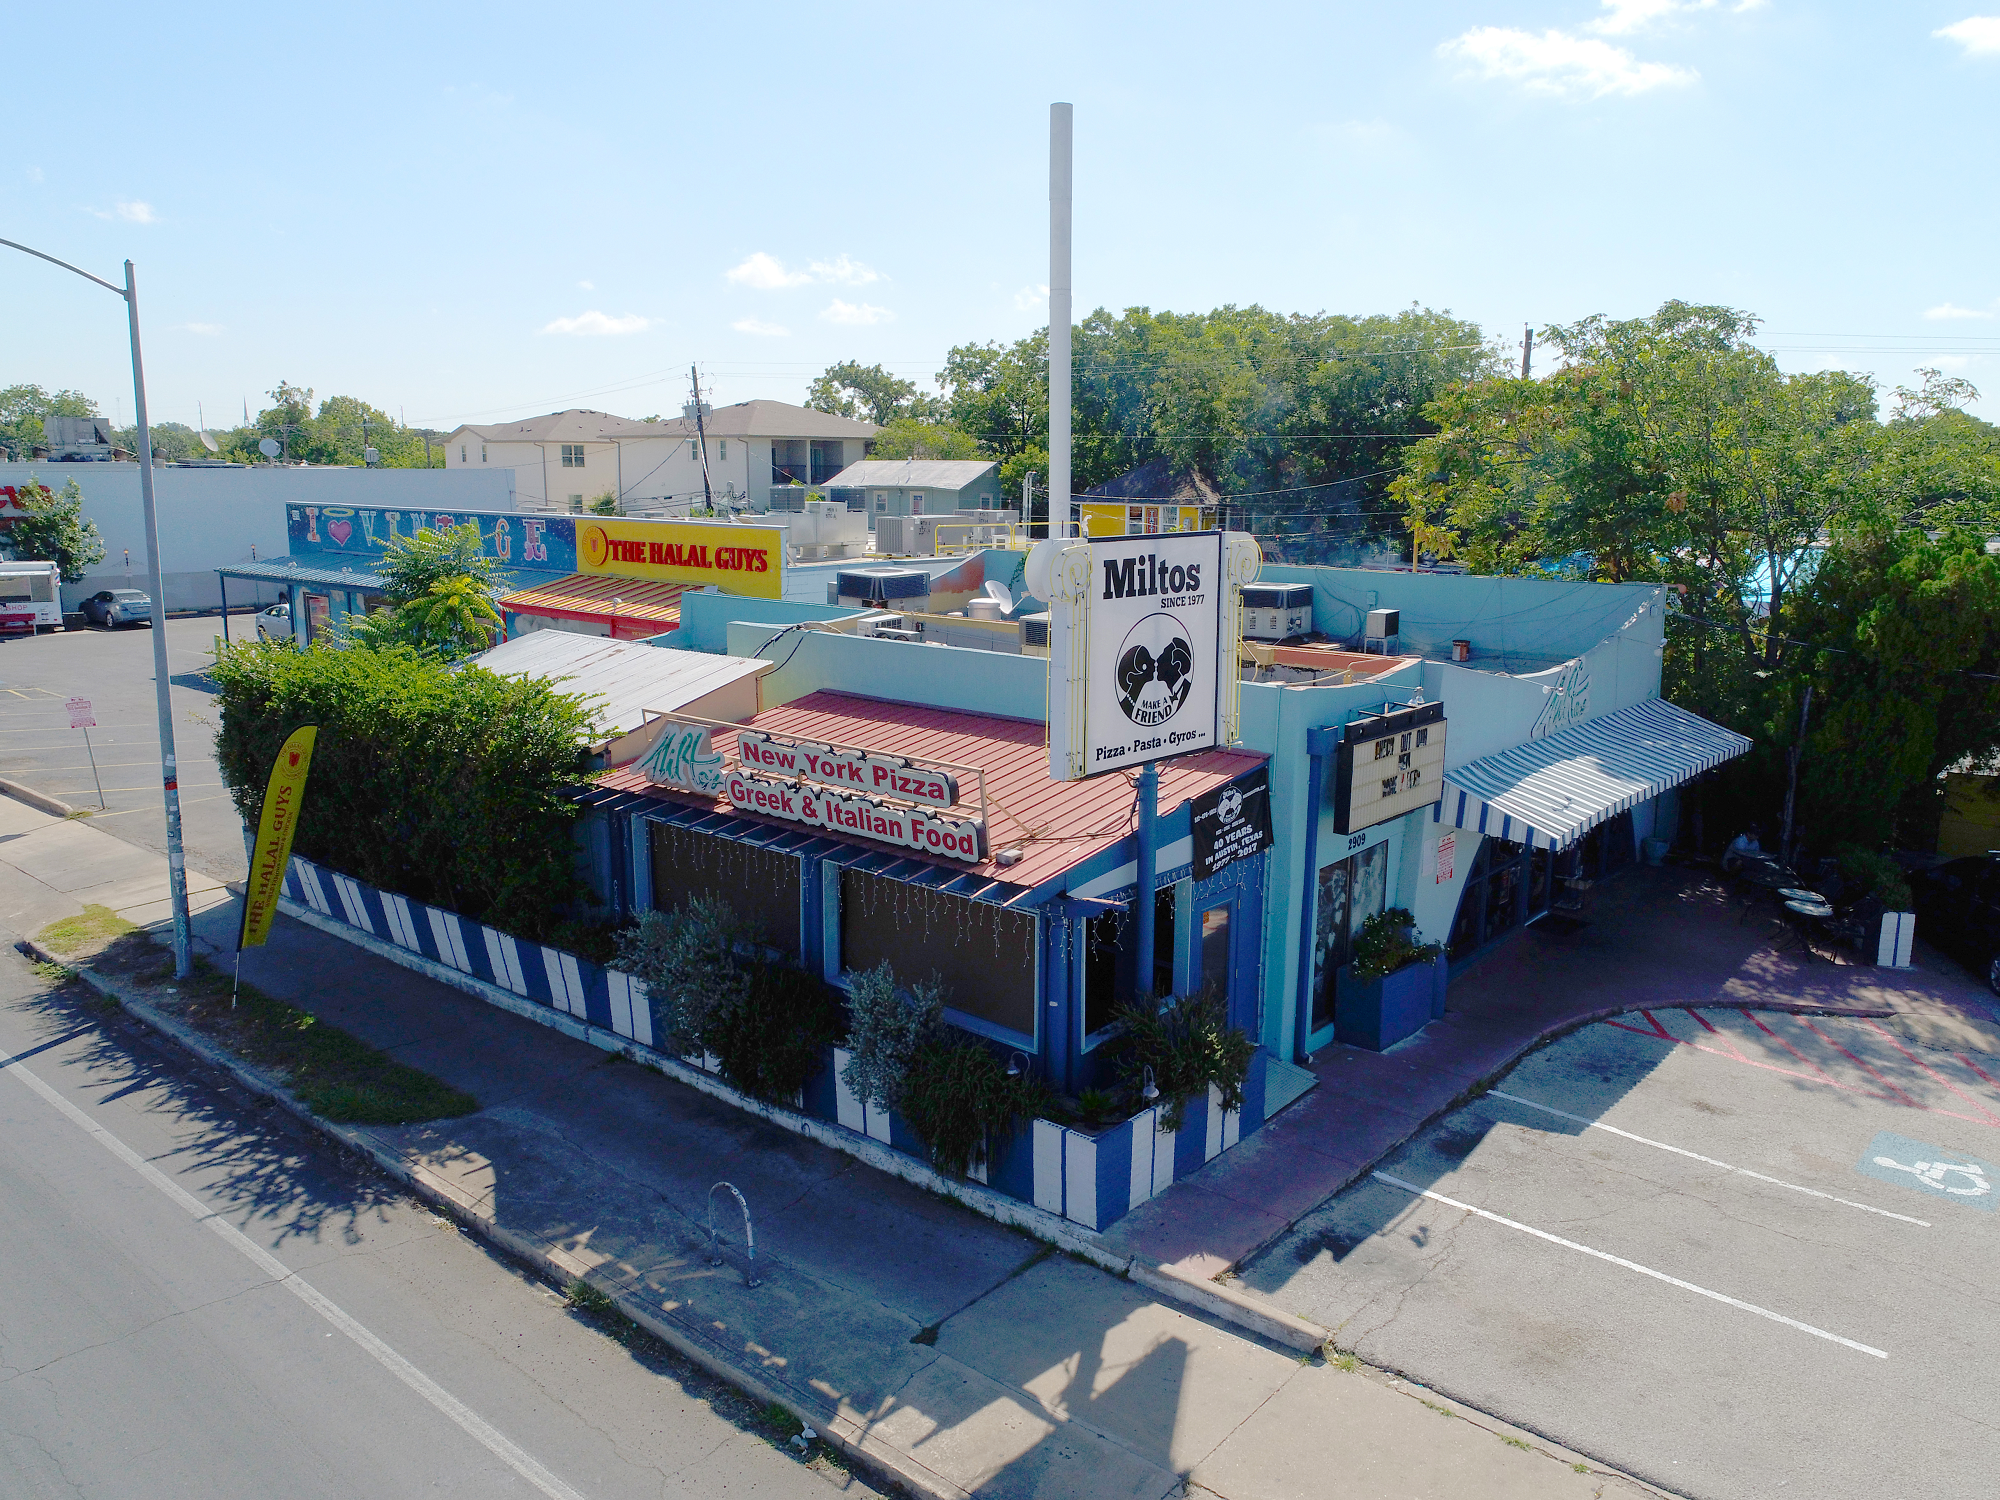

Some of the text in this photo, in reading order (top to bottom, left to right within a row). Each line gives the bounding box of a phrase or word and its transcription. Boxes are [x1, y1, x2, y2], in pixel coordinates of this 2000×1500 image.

[306, 507, 319, 542] I
[609, 539, 646, 563] THE
[649, 542, 712, 568] HALAL
[715, 546, 767, 572] GUYS
[1103, 554, 1200, 600] Miltos
[1161, 594, 1205, 609] SINCE 1977
[1134, 704, 1172, 723] FRIEND
[1141, 699, 1161, 709] MAKE
[1096, 746, 1125, 761] Pizza
[1133, 737, 1161, 752] Pasta
[742, 741, 945, 800] New York Pizza
[730, 780, 974, 855] Greek & Italian Food
[1205, 855, 1214, 865] IN
[1241, 830, 1263, 846] TEXAS
[1213, 838, 1224, 850] 40
[1225, 824, 1253, 844] YEARS
[1348, 833, 1366, 850] 2909
[248, 785, 292, 934] THE HALAL GUYS
[1212, 856, 1230, 872] 1977
[1237, 842, 1258, 858] 2017
